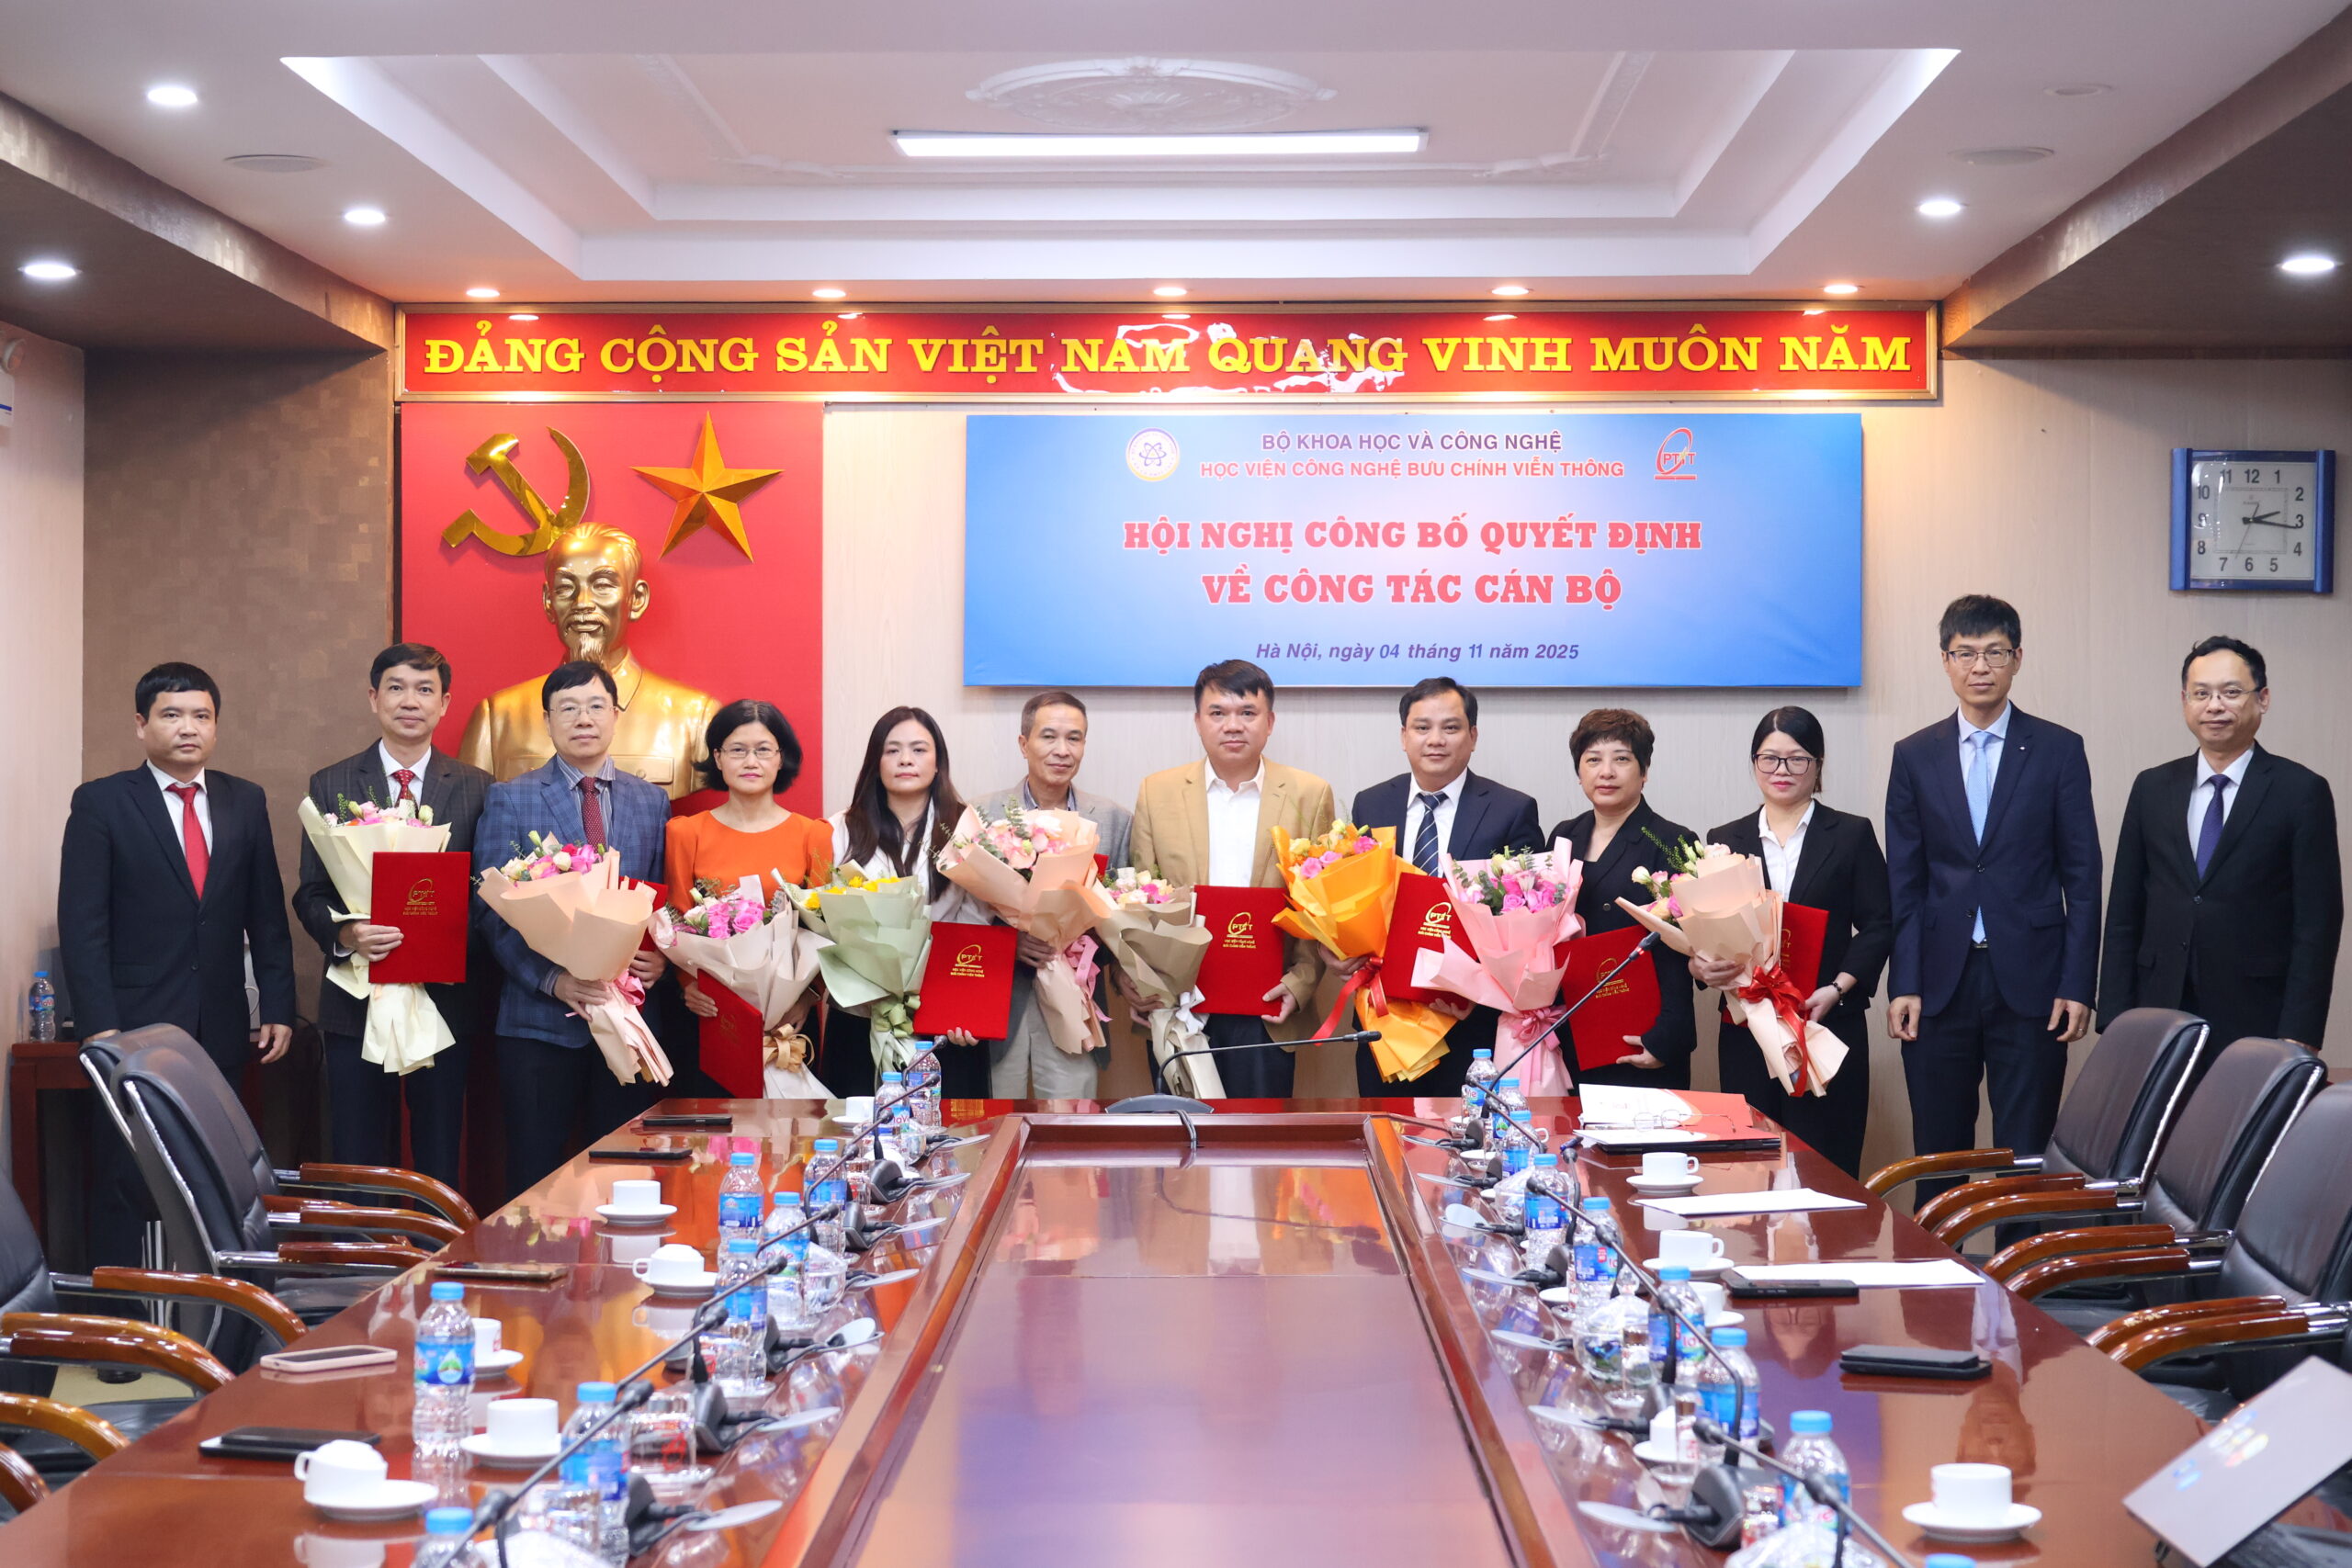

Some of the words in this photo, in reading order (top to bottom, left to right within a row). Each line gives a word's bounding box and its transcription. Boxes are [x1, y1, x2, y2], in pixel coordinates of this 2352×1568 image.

[424, 320, 585, 373] ĐẢNG
[600, 327, 760, 383] CỘNG
[775, 320, 893, 373] SẢN
[907, 326, 1044, 384] VIỆT
[1060, 337, 1192, 373] NAM
[1207, 337, 1408, 374] QUANG
[1421, 336, 1572, 374] VINH
[1589, 323, 1763, 372] MUÔN
[1779, 324, 1911, 371] NĂM
[1261, 431, 1291, 453] BỘ
[1297, 434, 1352, 450] KHOA
[1359, 434, 1401, 453] HỌC
[1408, 431, 1434, 450] VÀ
[1440, 431, 1498, 450] CÔNG
[1505, 431, 1562, 453] NGHỆ
[1201, 461, 1239, 479] HỌC
[1245, 458, 1286, 479] VIỆN
[1292, 458, 1345, 477] CÔNG
[1351, 458, 1401, 479] NGHỆ
[1408, 461, 1445, 477] BƯU
[1450, 459, 1507, 477] CHÍNH
[1512, 457, 1555, 477] VIỄN
[1560, 458, 1624, 477] THÔNG
[2220, 469, 2233, 483] 11
[2245, 469, 2260, 483] 12
[2274, 469, 2280, 483] 1
[2198, 485, 2210, 500] 10
[2295, 487, 2304, 502] 2
[2295, 514, 2304, 529] 3
[1124, 516, 1191, 555] HỘI
[1201, 522, 1294, 554] NGHỊ
[1305, 515, 1406, 548] CÔNG
[1417, 513, 1469, 548] BỐ
[1480, 513, 1598, 555] QUYẾT
[1608, 522, 1702, 555] ĐỊNH
[2198, 540, 2206, 555] 8
[2293, 542, 2302, 557] 4
[2219, 558, 2228, 571] 7
[2245, 558, 2254, 571] 6
[2269, 558, 2278, 572] 5
[1202, 563, 1251, 604] VỀ
[1263, 568, 1374, 604] CÔNG
[1385, 568, 1463, 604] TÁC
[1475, 568, 1555, 604] CÁN
[1566, 568, 1622, 610] BỘ
[1255, 643, 1281, 659] Hà
[1285, 643, 1322, 661] Nội,
[1329, 643, 1374, 662] ngày
[1379, 644, 1400, 659] 04
[1408, 643, 1462, 662] tháng
[1469, 644, 1483, 659] 11
[1489, 643, 1530, 659] năm
[1534, 644, 1579, 659] 2025
